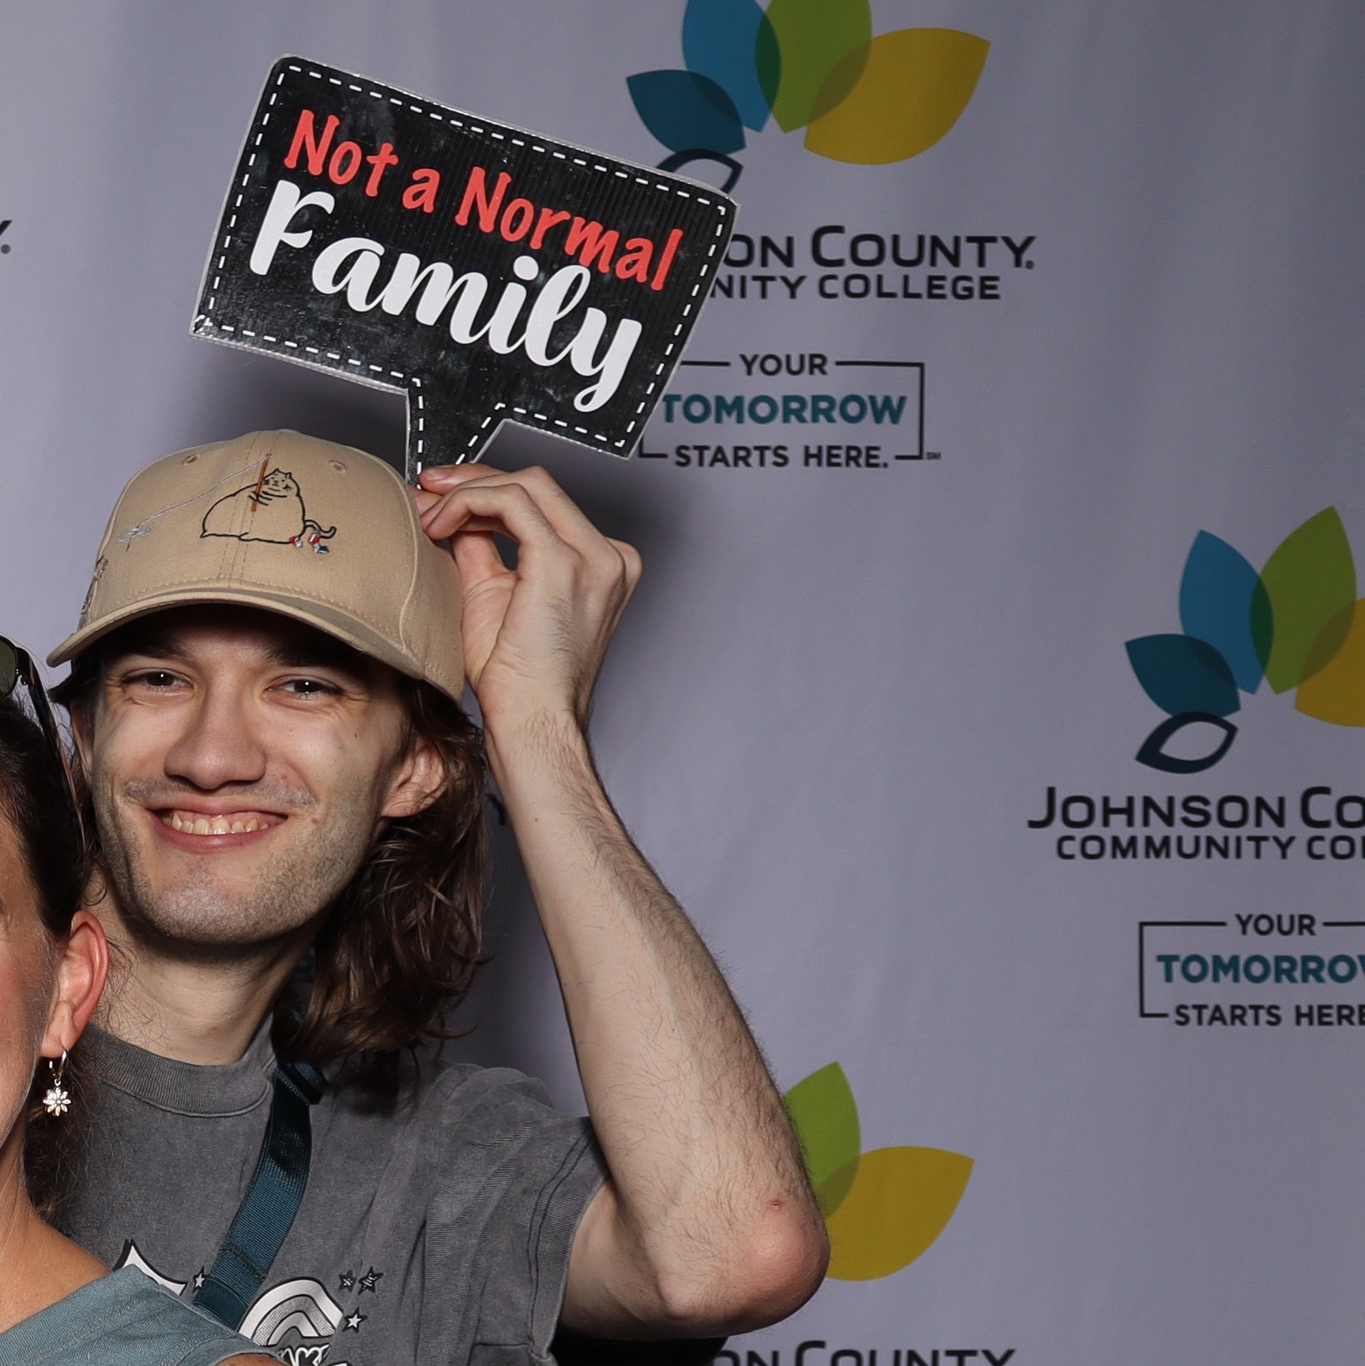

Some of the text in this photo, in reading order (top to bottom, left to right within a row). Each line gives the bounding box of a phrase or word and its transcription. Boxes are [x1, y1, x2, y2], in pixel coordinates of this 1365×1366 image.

[283, 109, 683, 291] Not a Normal
[250, 179, 644, 413] Family
[819, 273, 1001, 301] COLLEGE
[739, 353, 828, 376] YOUR
[662, 393, 907, 426] TOMORROW
[674, 445, 790, 468] STARTS
[804, 445, 889, 468] HERE.
[1027, 786, 1285, 829] JOHNSON
[1057, 834, 1296, 860] COMMUNITY
[1235, 914, 1316, 937] YOUR
[1156, 954, 1365, 984] TOMORRO
[1175, 1004, 1282, 1027] STARTS
